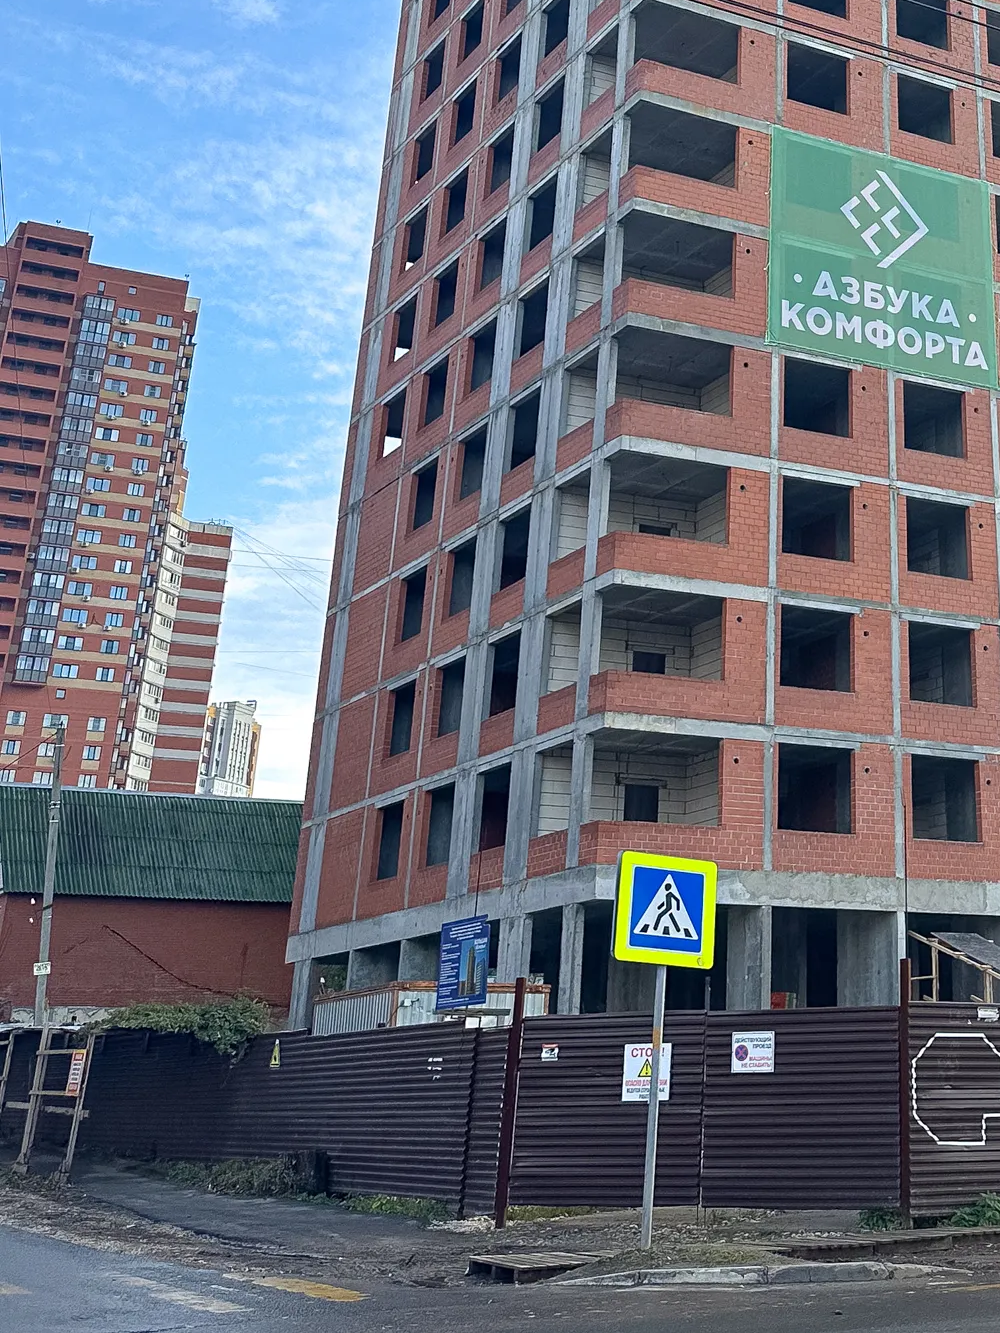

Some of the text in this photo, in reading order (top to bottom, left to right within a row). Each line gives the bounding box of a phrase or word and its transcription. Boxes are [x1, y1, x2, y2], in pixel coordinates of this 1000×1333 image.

[811, 270, 961, 328] АЗБУКА
[780, 299, 989, 371] КОМФОРТА
[631, 1047, 665, 1058] СТО!
